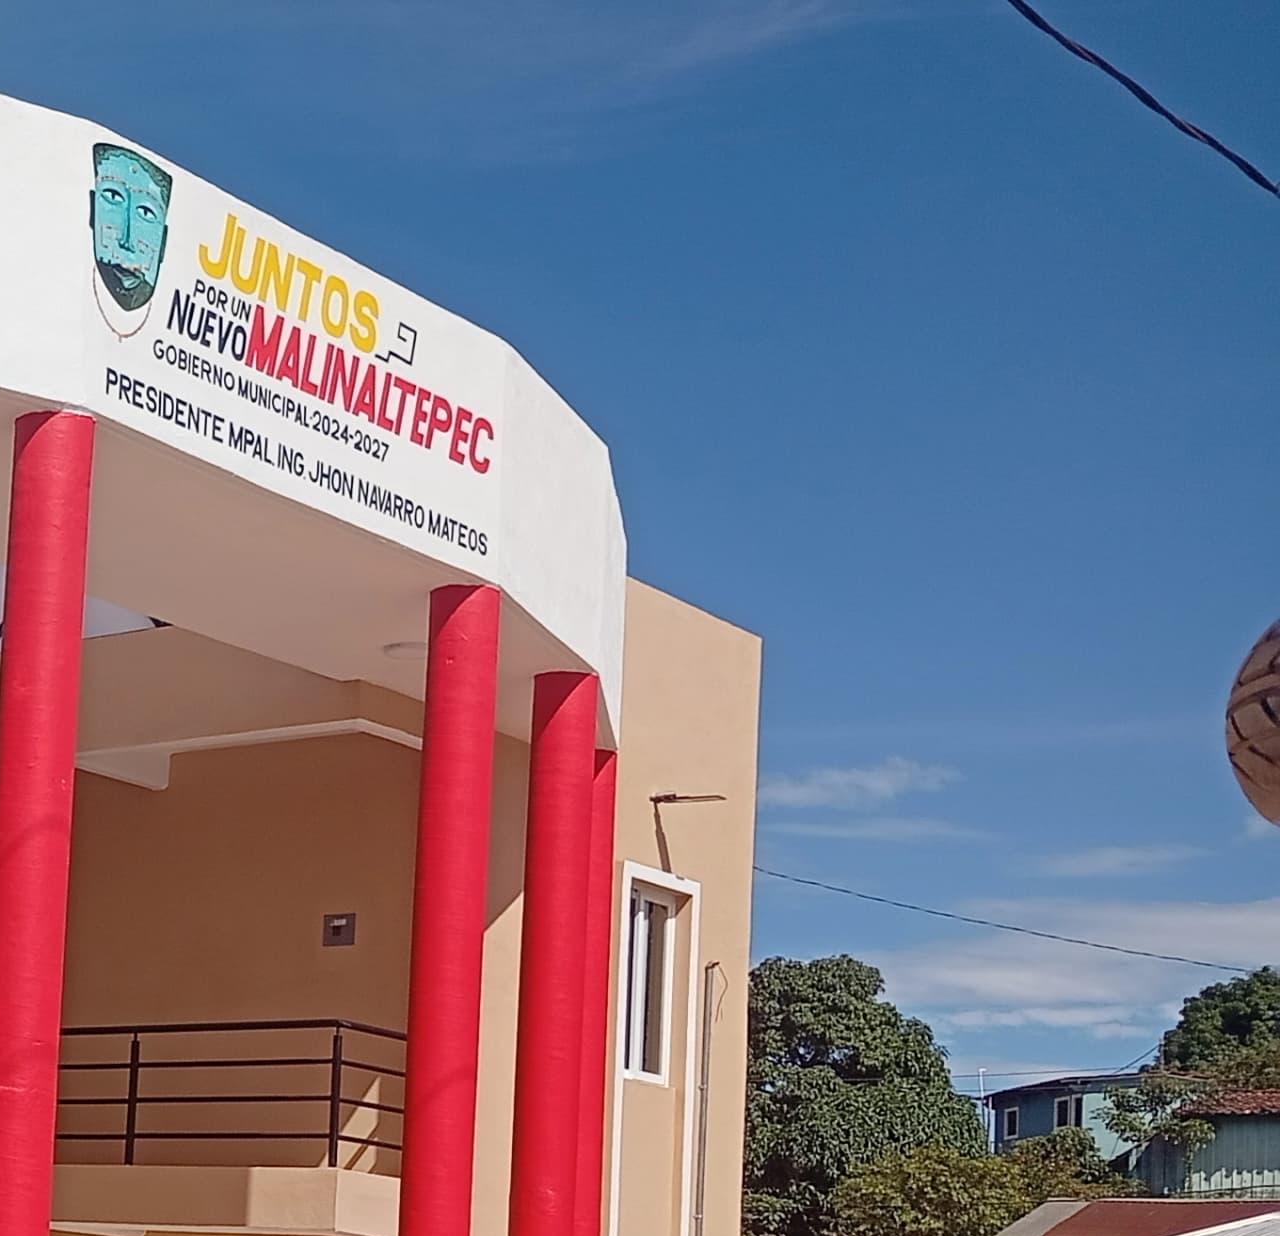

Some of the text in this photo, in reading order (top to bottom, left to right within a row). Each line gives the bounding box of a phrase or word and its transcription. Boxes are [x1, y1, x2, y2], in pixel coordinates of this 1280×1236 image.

[193, 279, 252, 323] POR UN
[199, 213, 379, 353] JUNTOS
[153, 339, 235, 391] GOBIERNO
[167, 289, 494, 474] NUEVO MALINALTEPEC
[106, 367, 225, 444] PRESIDENTE
[308, 460, 354, 499] JHON
[357, 478, 425, 530] NAVARRO
[428, 510, 488, 556] MATEOS
